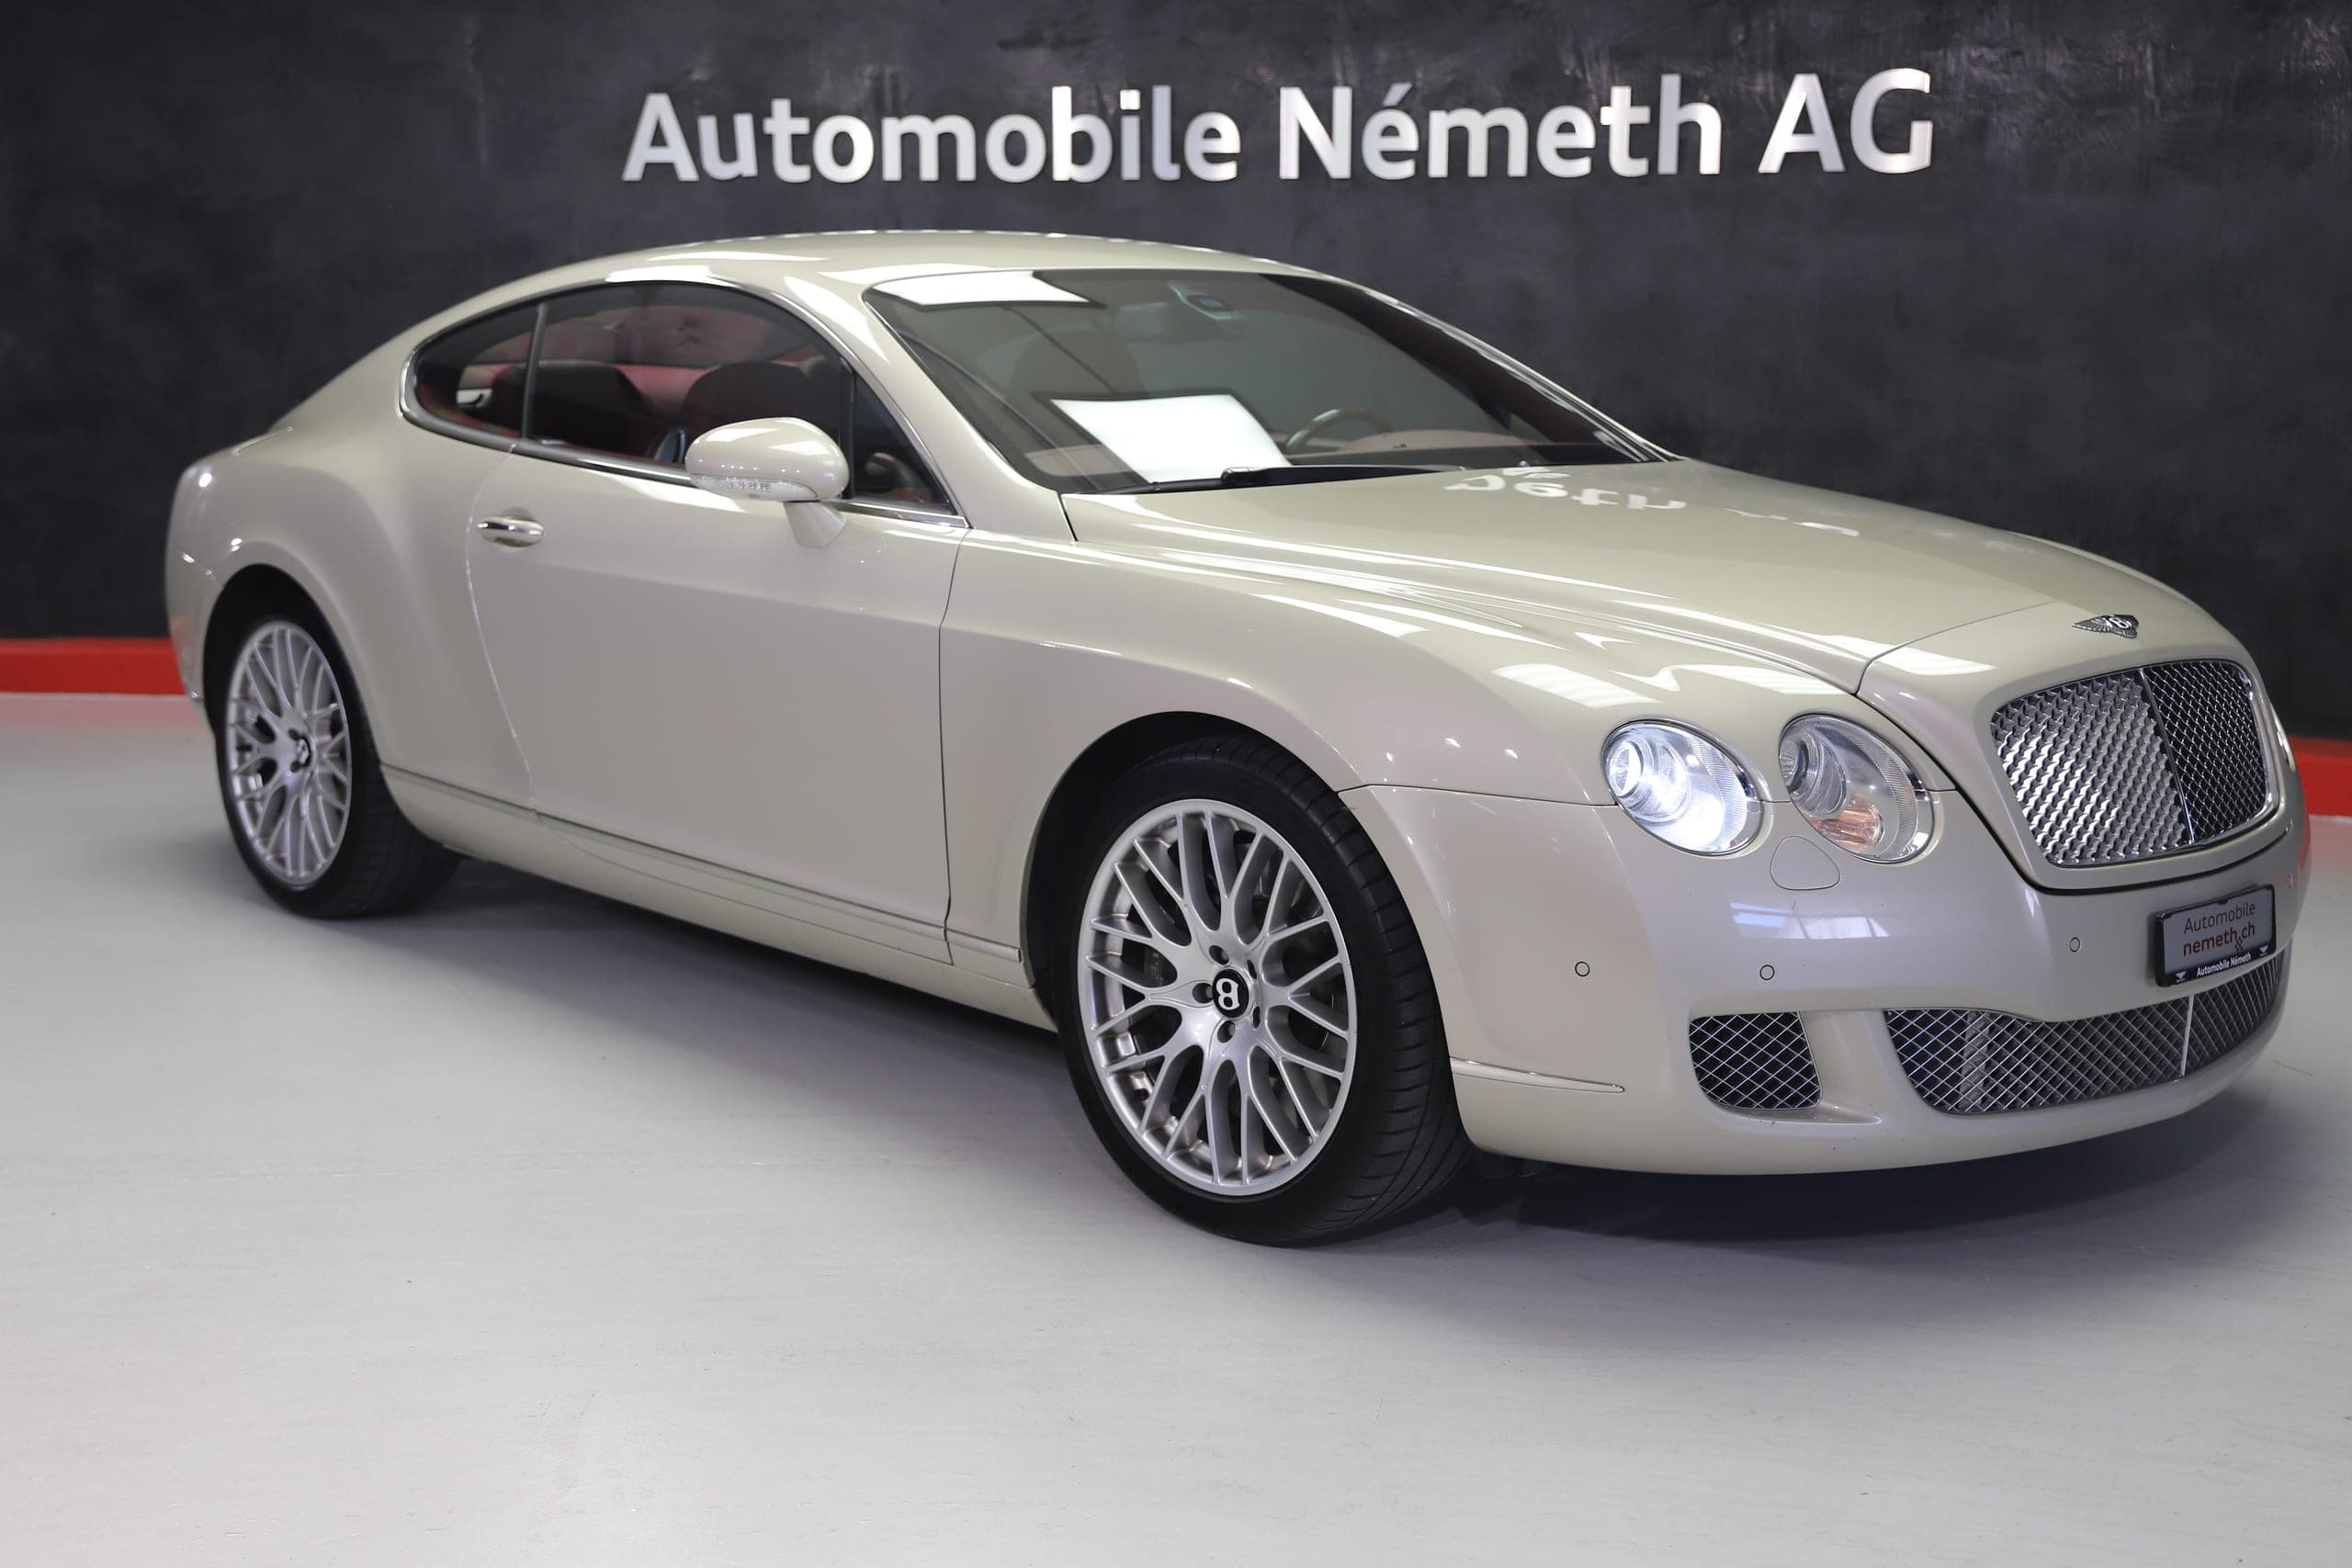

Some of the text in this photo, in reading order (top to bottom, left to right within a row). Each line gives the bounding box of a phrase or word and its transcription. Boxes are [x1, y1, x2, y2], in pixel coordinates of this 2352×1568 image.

[622, 67, 1932, 183] Automobile Németh AG
[2183, 901, 2256, 934] Automobile
[2183, 921, 2256, 956] nemeth.ch
[2197, 953, 2252, 976] Automobile Németh
